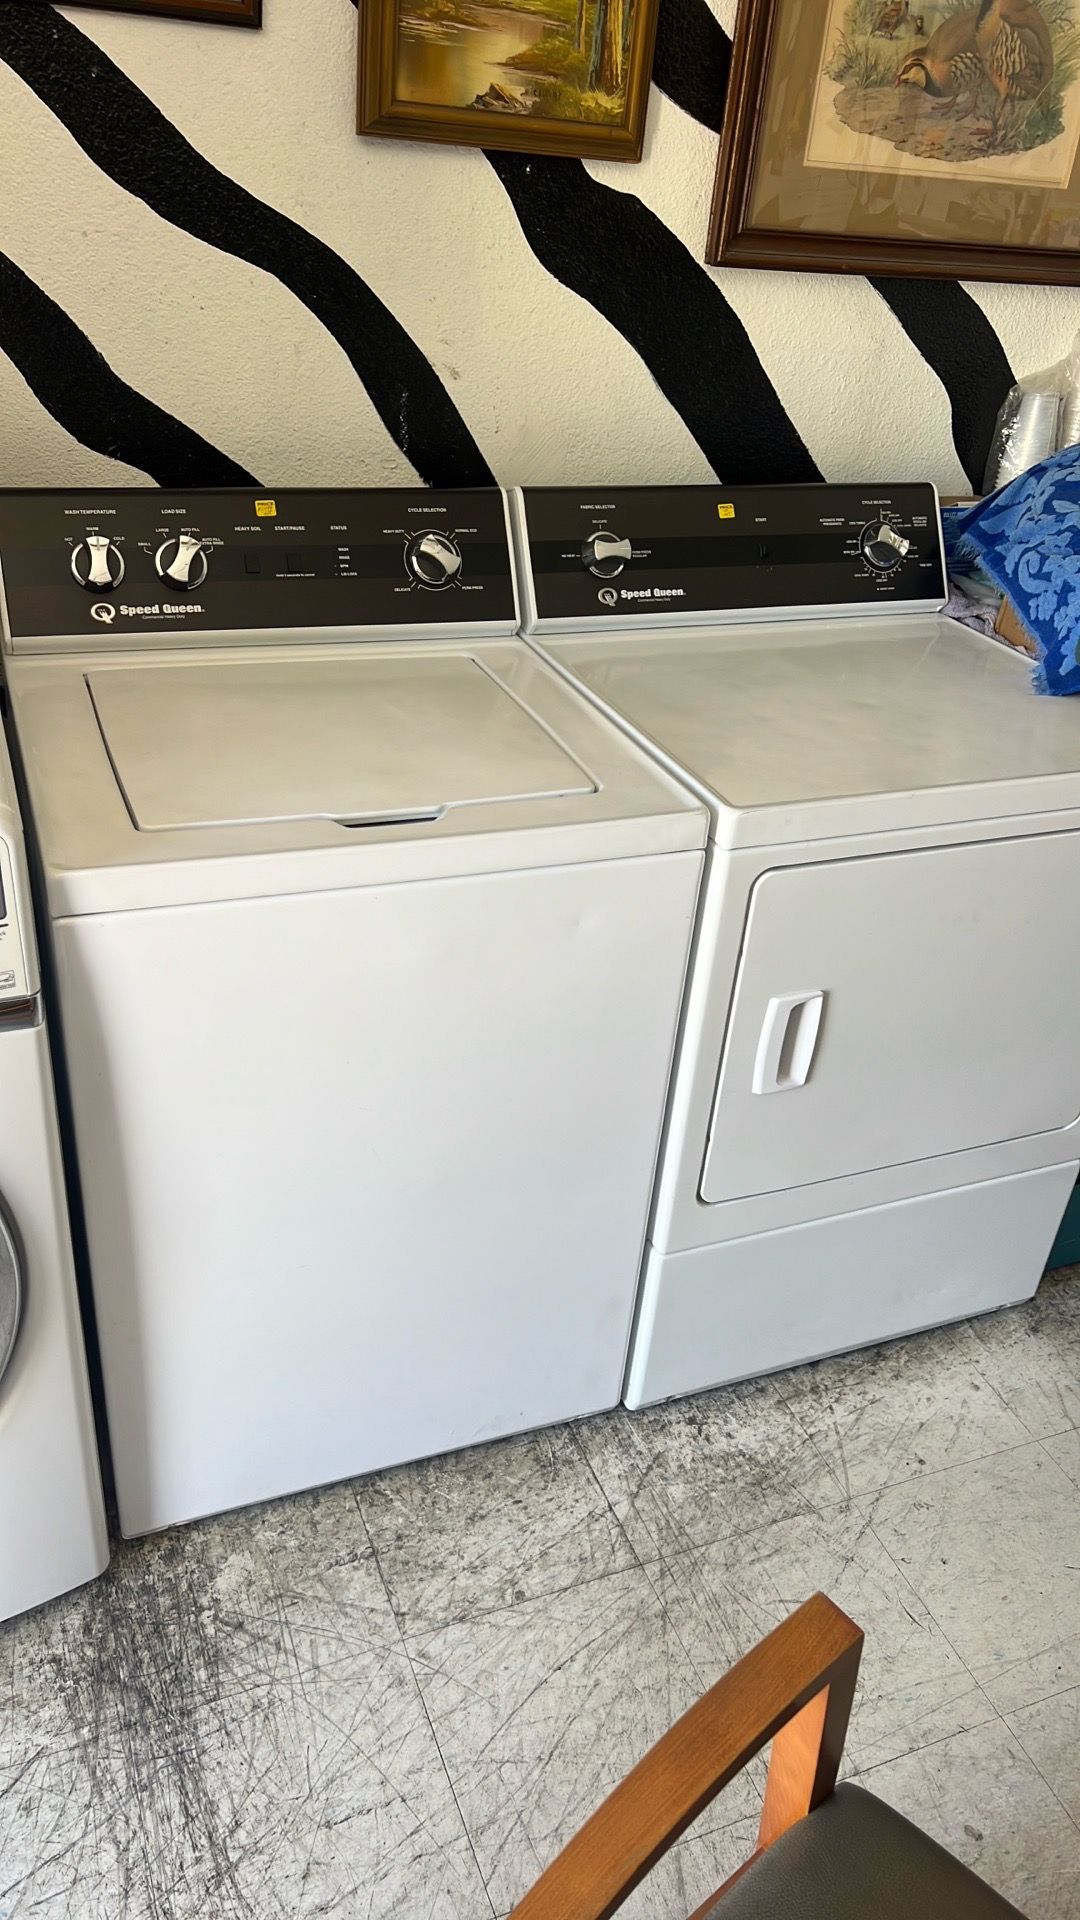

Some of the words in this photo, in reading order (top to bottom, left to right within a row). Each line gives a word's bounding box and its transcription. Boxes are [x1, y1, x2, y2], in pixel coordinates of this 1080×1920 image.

[620, 589, 651, 599] Speed
[654, 588, 684, 597] Queen
[120, 604, 160, 616] Speed
[163, 604, 202, 614] Queen
